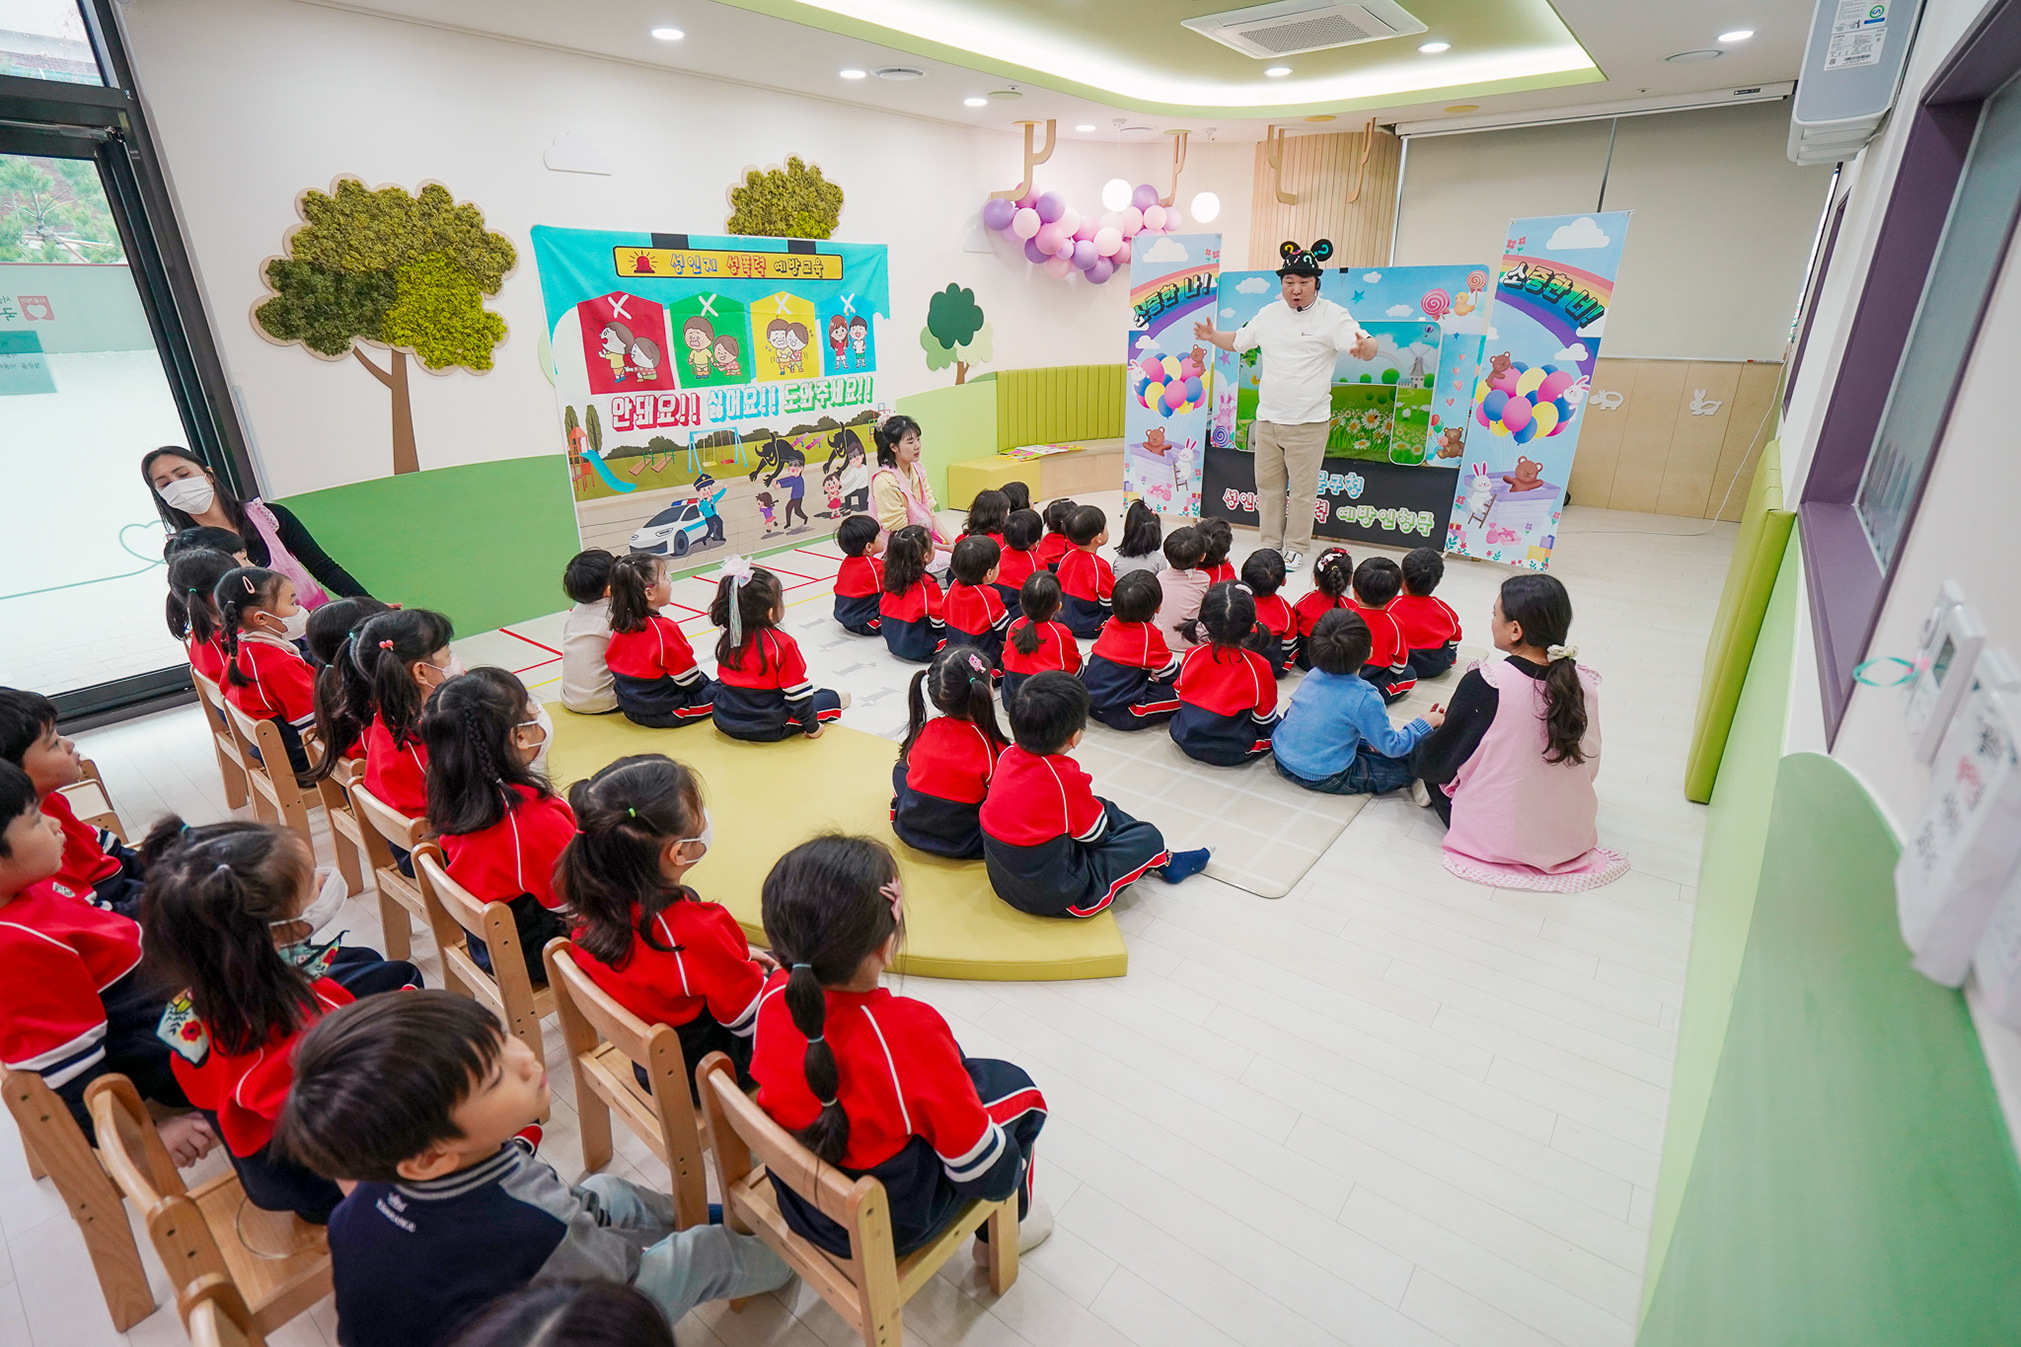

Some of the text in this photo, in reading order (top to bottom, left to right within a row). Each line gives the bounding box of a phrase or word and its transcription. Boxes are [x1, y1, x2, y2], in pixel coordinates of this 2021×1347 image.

[669, 253, 824, 279] 성인지 성폭력 예방교육
[1133, 271, 1213, 328] 소중한 나!
[1502, 261, 1605, 329] 소중한 너!
[611, 375, 874, 432] 안돼요!! 싫어요!! 도와주세요!!
[1287, 470, 1365, 499] 문구청
[1223, 487, 1260, 512] 성인
[1336, 504, 1435, 538] 예방인형극
